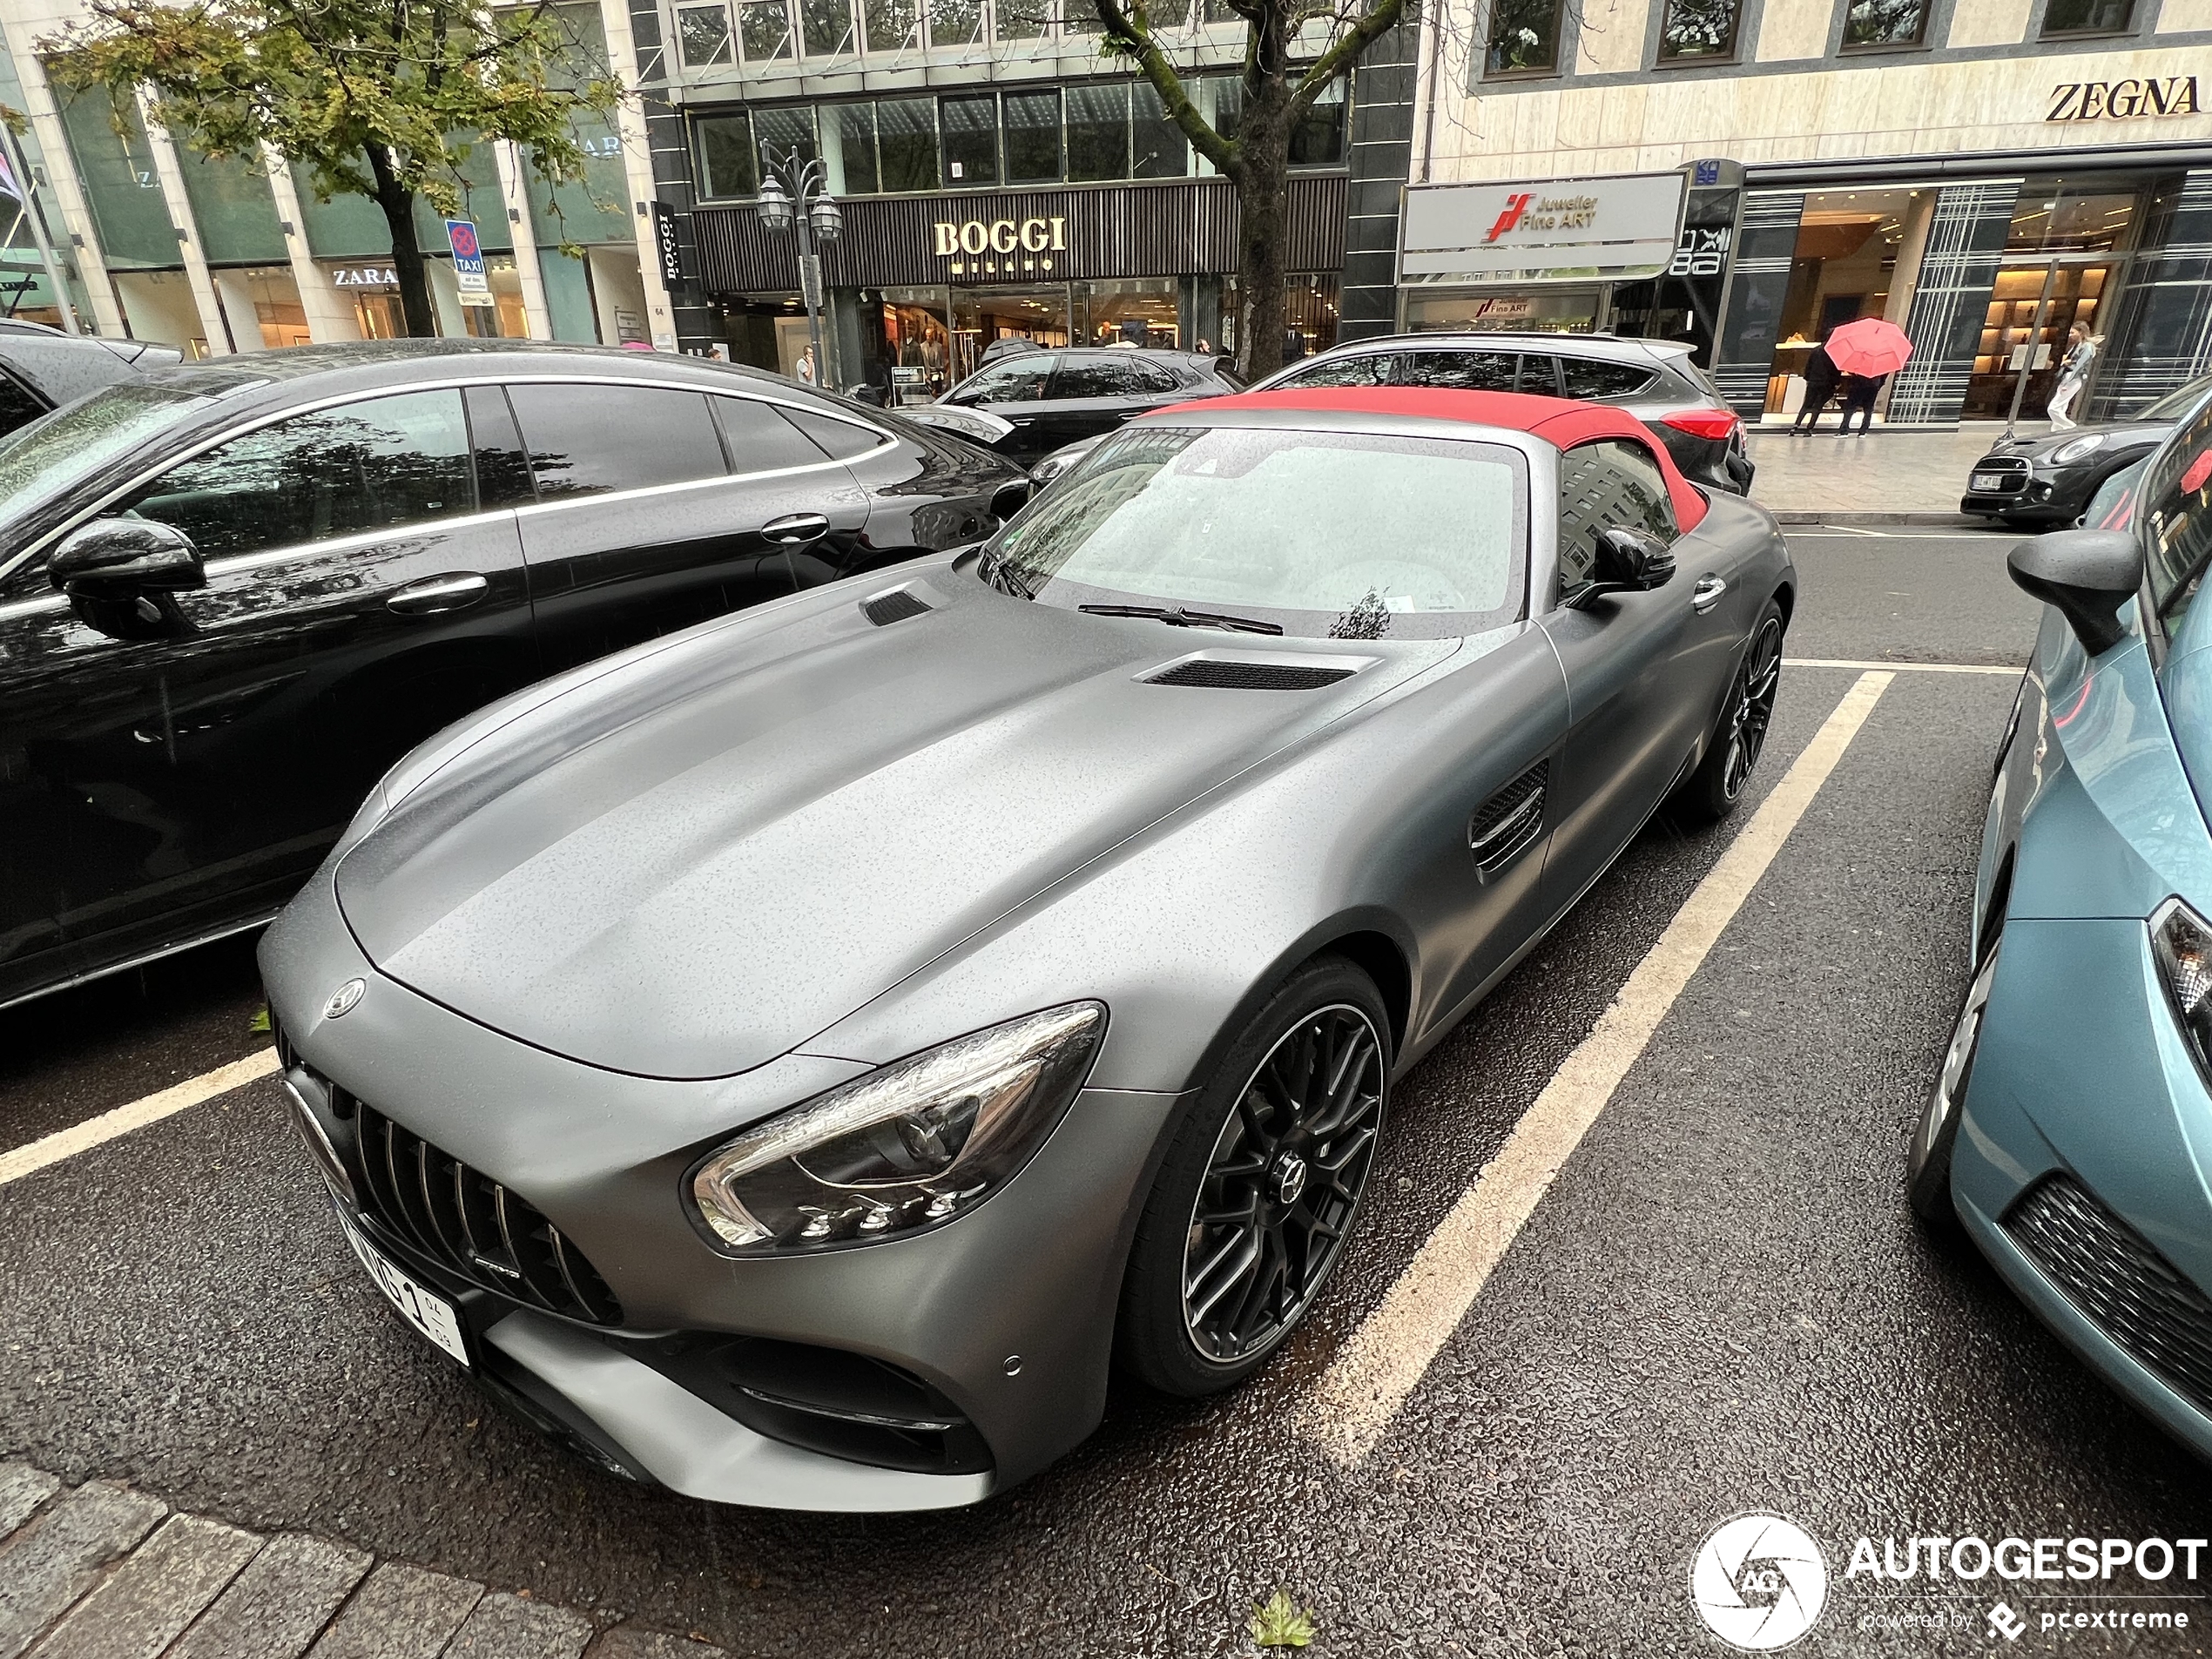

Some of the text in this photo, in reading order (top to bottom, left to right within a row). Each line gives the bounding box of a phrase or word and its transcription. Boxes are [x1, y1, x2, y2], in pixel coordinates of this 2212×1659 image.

[2046, 76, 2202, 122] ZEGNA
[1520, 211, 1596, 231] Fine ART
[934, 218, 1066, 255] BOGGI
[658, 213, 677, 280] BOGGI
[457, 260, 482, 273] TAXI
[951, 259, 1053, 275] MILANO
[333, 268, 399, 286] ZARA
[1510, 304, 1528, 313] ART
